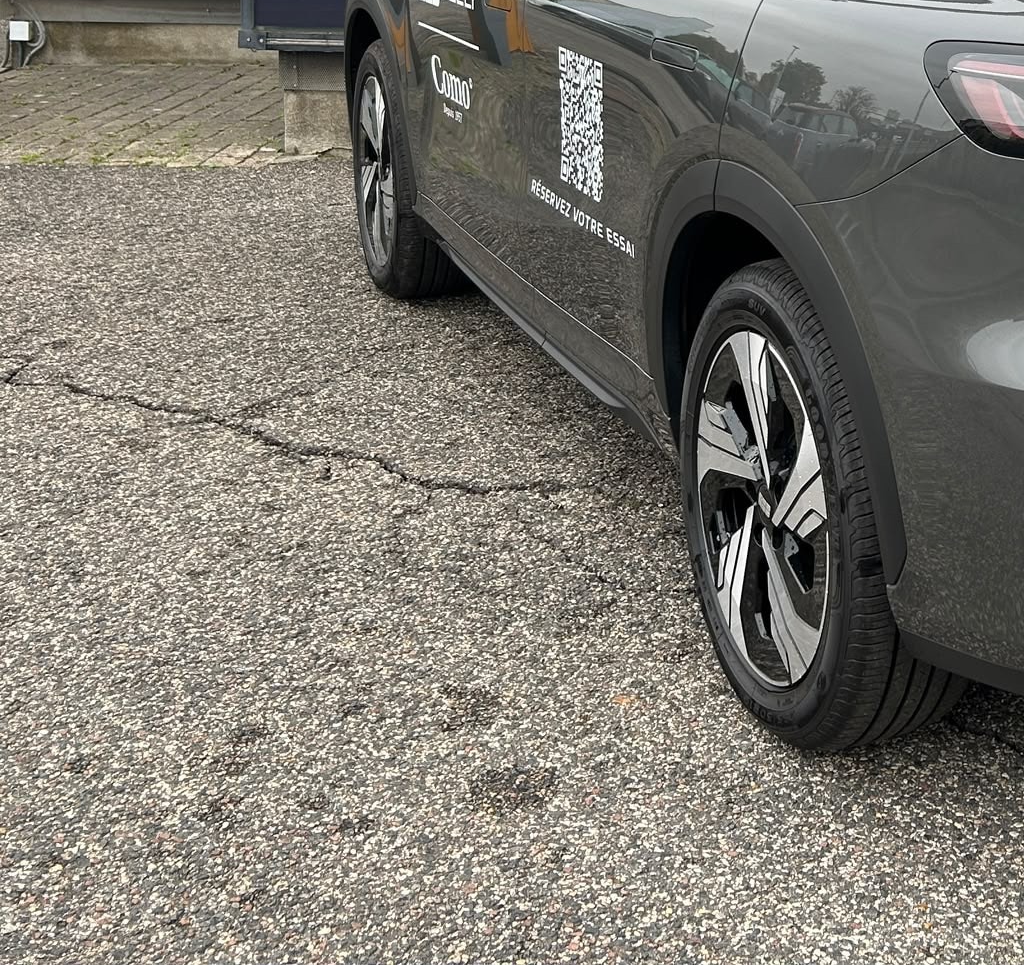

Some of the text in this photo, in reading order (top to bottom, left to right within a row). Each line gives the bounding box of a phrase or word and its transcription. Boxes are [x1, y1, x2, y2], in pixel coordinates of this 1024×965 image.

[530, 178, 635, 259] RÉSERVEZ VOTRE ESSAI
